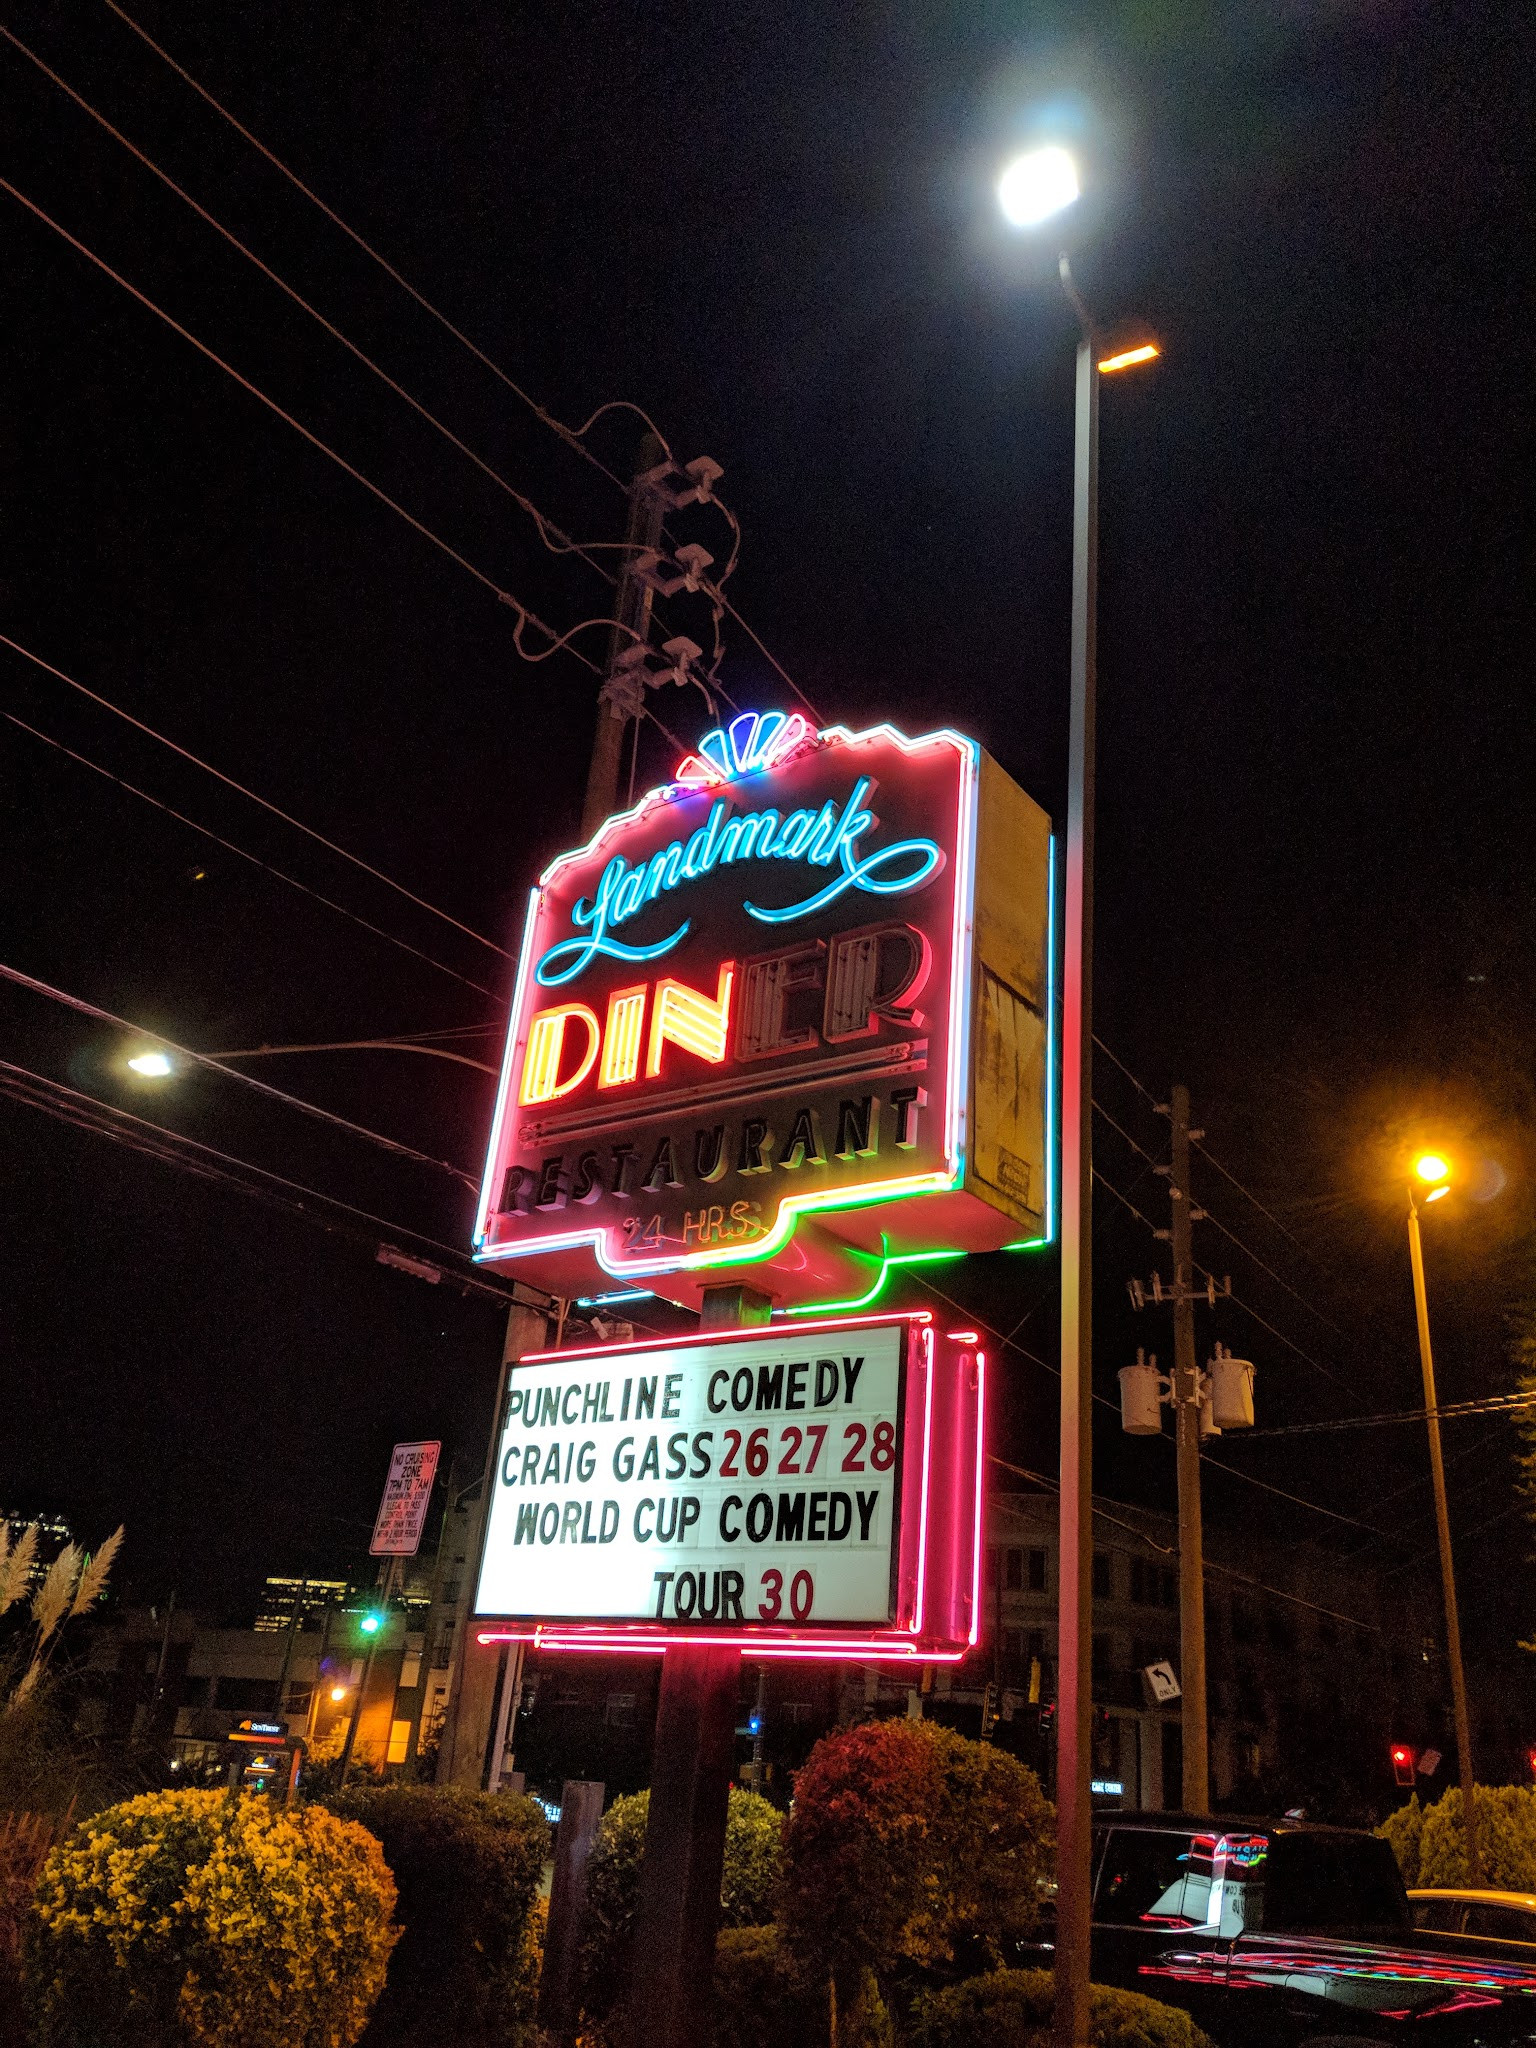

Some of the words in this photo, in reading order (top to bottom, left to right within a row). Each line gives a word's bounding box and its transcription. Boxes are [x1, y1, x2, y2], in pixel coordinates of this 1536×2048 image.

[535, 774, 946, 986] Landmark
[518, 922, 932, 1107] DINER
[498, 1086, 927, 1217] RESTAURANT
[622, 1213, 666, 1252] 24
[503, 1373, 683, 1429] PUNCHLINE
[707, 1357, 865, 1413] COMEDY
[394, 1454, 404, 1465] NO
[405, 1452, 435, 1464] CRUISING
[401, 1466, 422, 1478] ZONE
[502, 1441, 596, 1487] CRAIG
[612, 1431, 713, 1482] GASS
[719, 1428, 769, 1477] 26
[778, 1425, 828, 1474] 27
[842, 1421, 895, 1472] 28
[389, 1480, 402, 1491] 7PM
[404, 1479, 412, 1490] TO
[415, 1478, 429, 1490] 7AM
[411, 1500, 421, 1509] PASS
[513, 1500, 620, 1545] WORLD
[633, 1496, 700, 1543] CUP
[719, 1491, 879, 1543] COMEDY
[654, 1571, 744, 1619] TOUR
[758, 1569, 814, 1619] 30
[1159, 1686, 1177, 1697] ONLY
